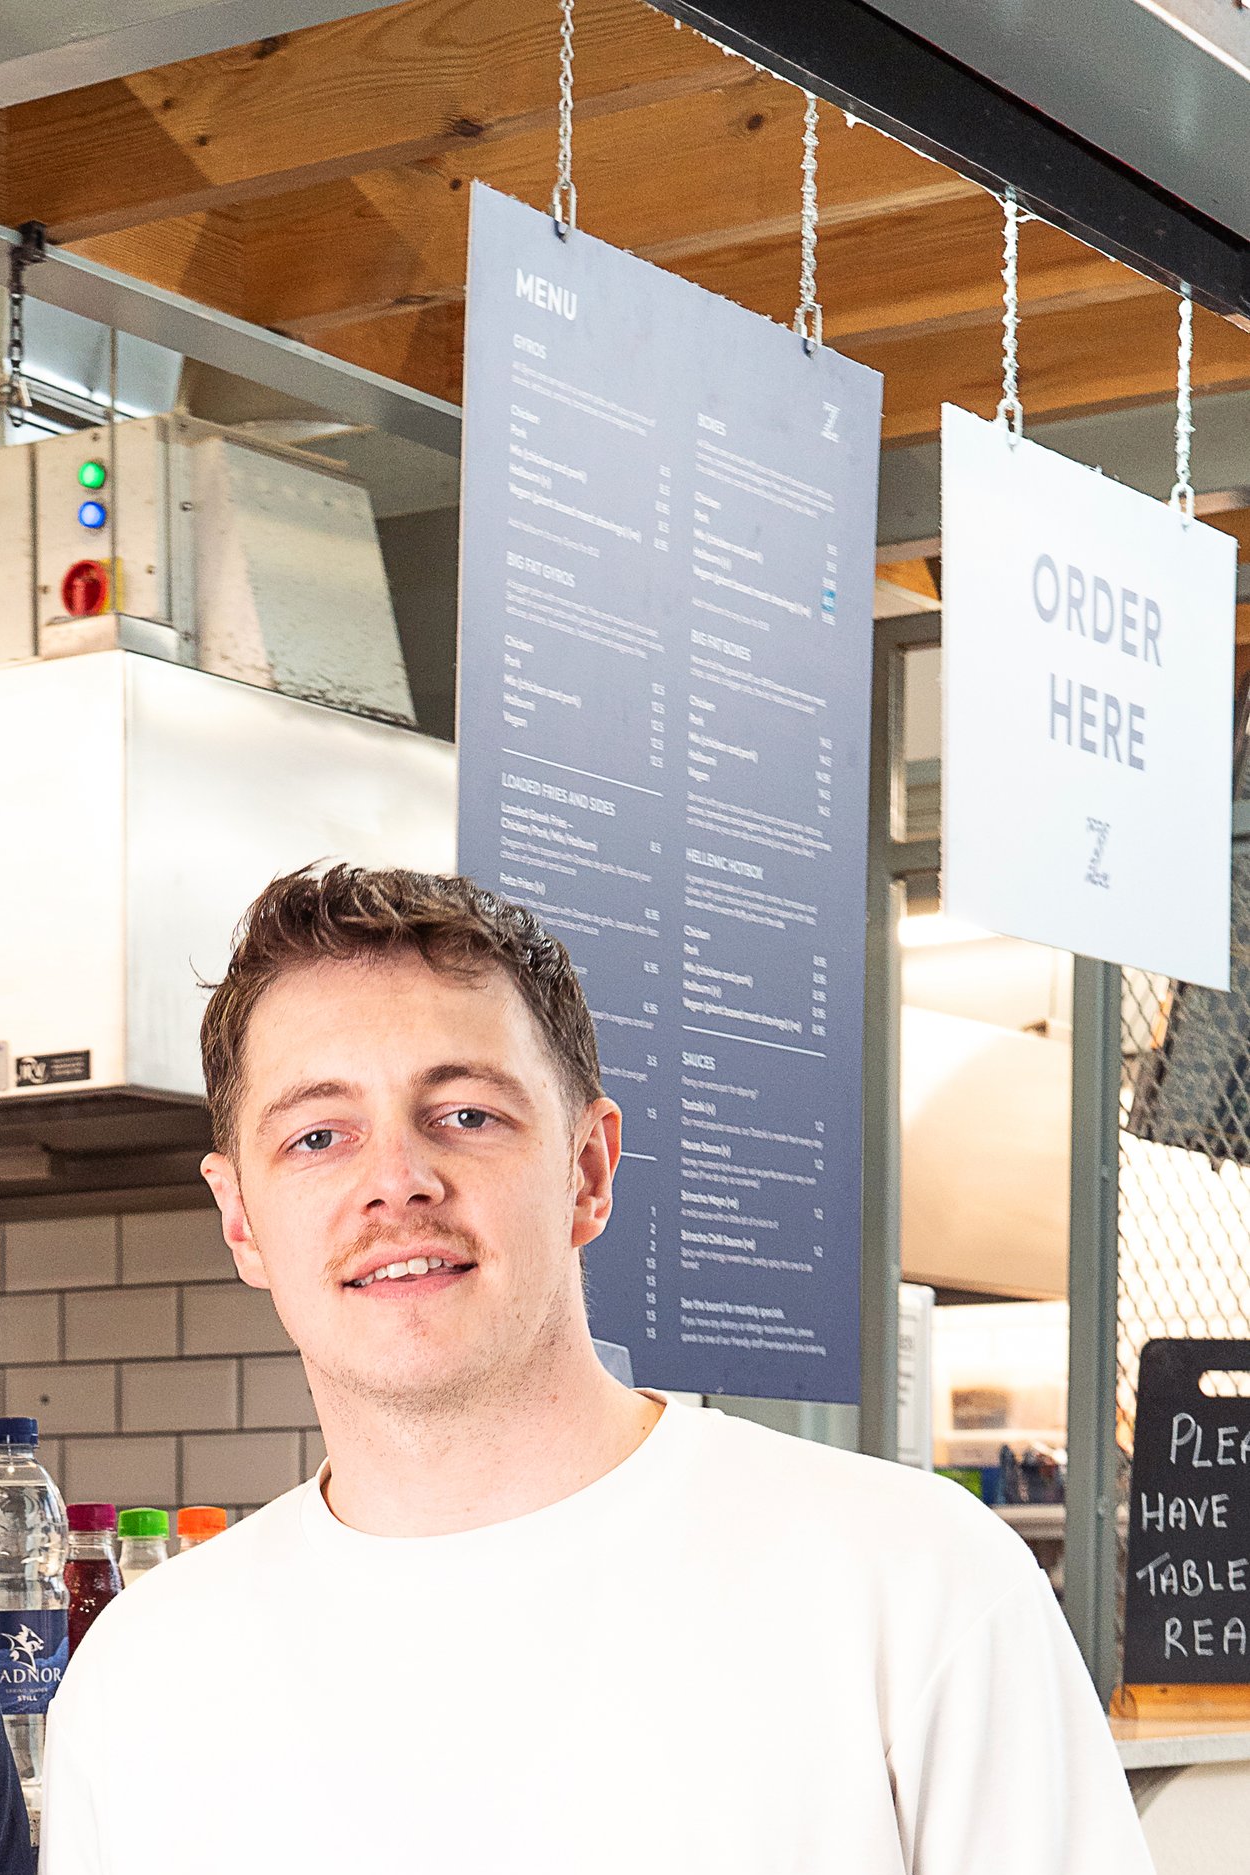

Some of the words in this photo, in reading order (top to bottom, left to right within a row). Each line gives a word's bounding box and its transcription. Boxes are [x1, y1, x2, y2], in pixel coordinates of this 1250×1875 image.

[516, 267, 578, 321] MENU
[513, 332, 547, 360] GYROS
[698, 412, 727, 437] BOXES
[506, 550, 524, 570] BIG
[525, 557, 541, 576] FAT
[542, 563, 575, 588] GYROS
[1032, 553, 1163, 667] ORDER
[504, 634, 534, 653] Chicken
[504, 653, 521, 668] Pork
[690, 628, 706, 646] BIG
[707, 634, 722, 652] FAT
[722, 639, 751, 661] BOXES
[1050, 672, 1147, 771] HERE
[501, 772, 540, 796] LOADED
[541, 783, 568, 804] FRIES
[568, 790, 588, 809] AND
[588, 795, 616, 816] SIDES
[685, 847, 728, 871] HELLENIC
[729, 858, 763, 880] HOTBOX
[681, 1051, 715, 1070] SAUCES
[1141, 1492, 1229, 1532] HAVE
[1136, 1552, 1249, 1597] TABLE
[1165, 1617, 1246, 1659] REA
